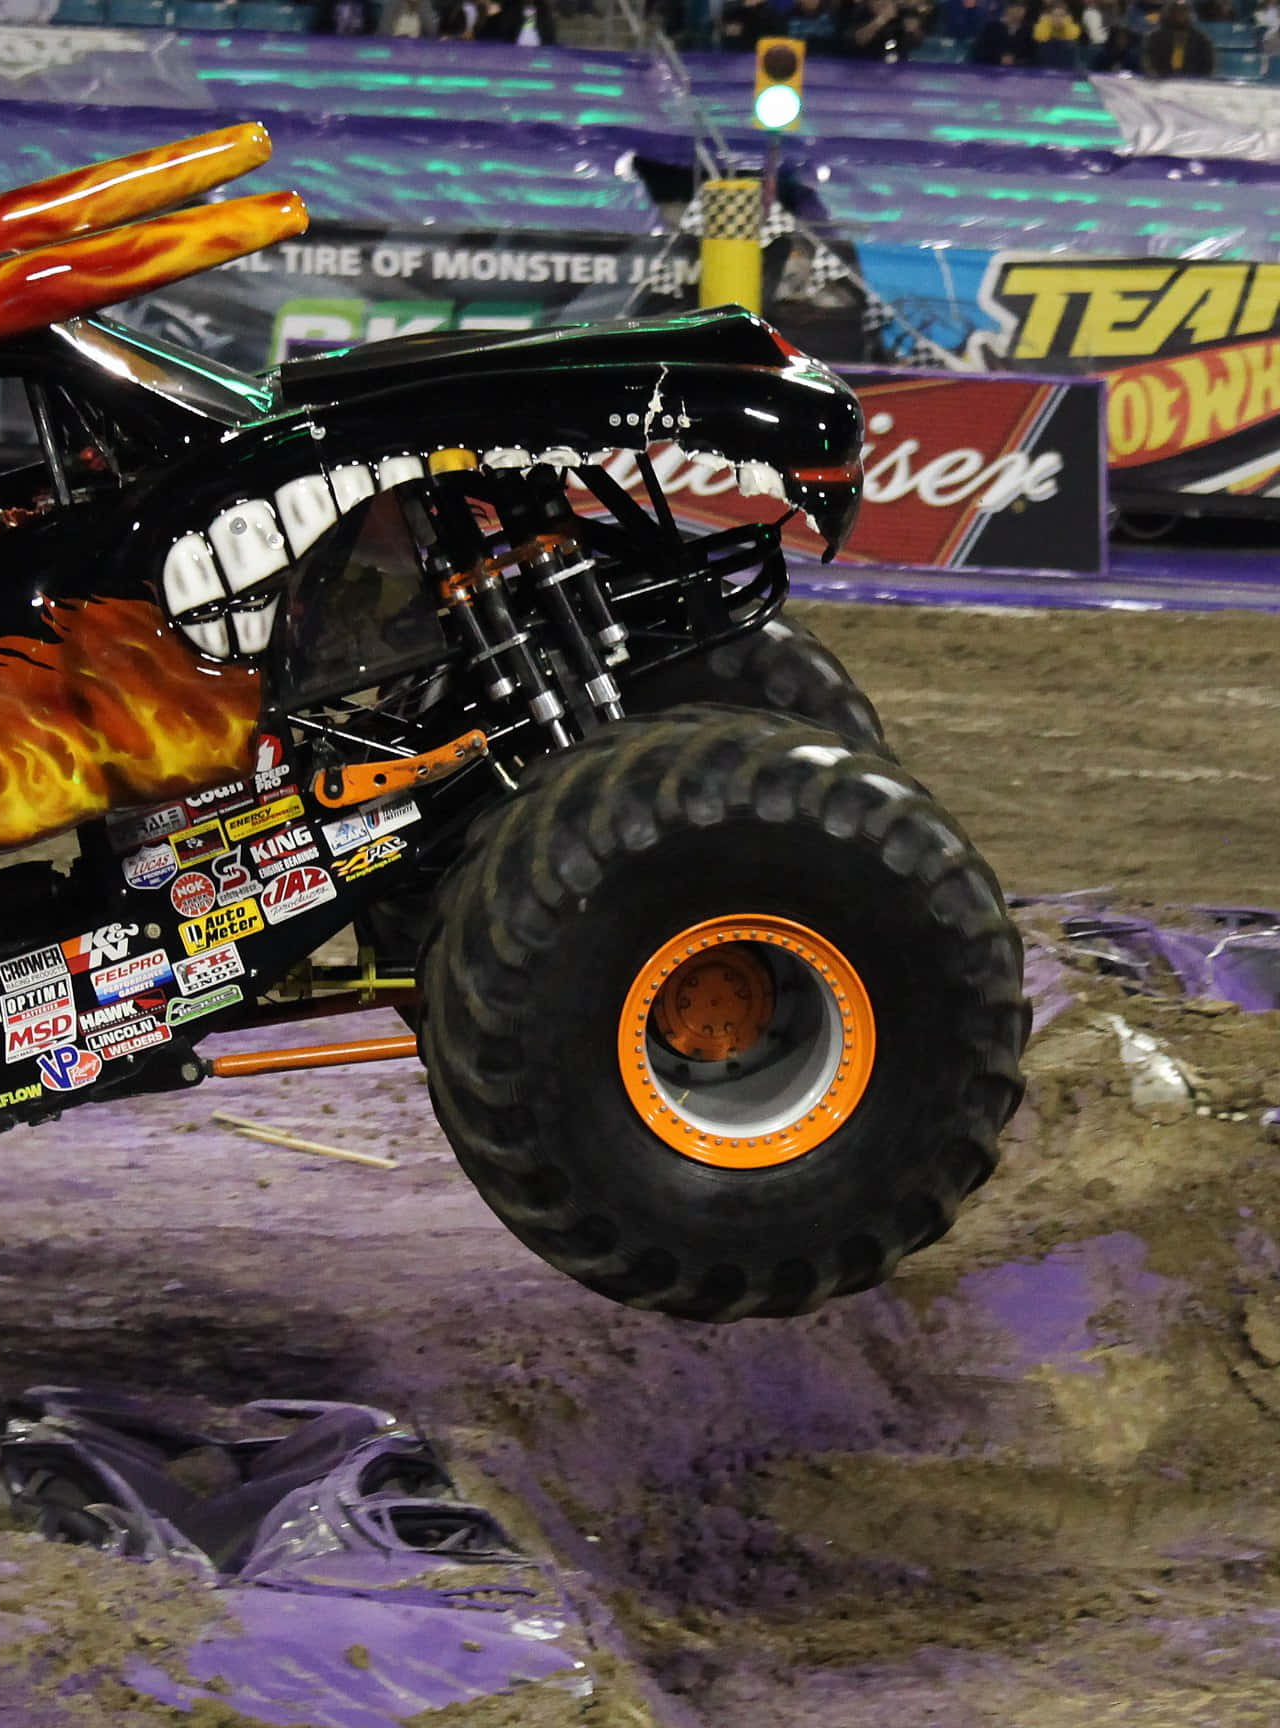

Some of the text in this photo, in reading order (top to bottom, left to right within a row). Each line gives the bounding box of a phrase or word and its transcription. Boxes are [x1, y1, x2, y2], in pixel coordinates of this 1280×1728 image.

[285, 245, 362, 277] TIRE
[372, 248, 422, 278] OF
[433, 250, 617, 284] MONSTER
[255, 764, 290, 782] SPEED
[256, 777, 282, 794] PRO
[229, 807, 272, 830] ENERGY
[249, 825, 314, 864] KING
[283, 846, 321, 870] BEARINGS
[133, 854, 170, 876] LUCAS
[175, 878, 205, 899] NGK
[263, 867, 329, 908] JAZ
[205, 906, 245, 930] Auto
[205, 915, 258, 948] Meter
[0, 947, 64, 982] CROWER
[93, 952, 164, 987] FEL-PRO
[185, 949, 235, 975] FK
[195, 960, 238, 980] ROD
[186, 967, 241, 992] ENDS
[6, 981, 68, 1015] OPTIMA
[79, 1000, 139, 1031] HAWK
[9, 1014, 73, 1052] MSD
[90, 1019, 156, 1049] LINCOLN
[108, 1030, 164, 1058] WELDERS
[38, 1045, 80, 1090] VP
